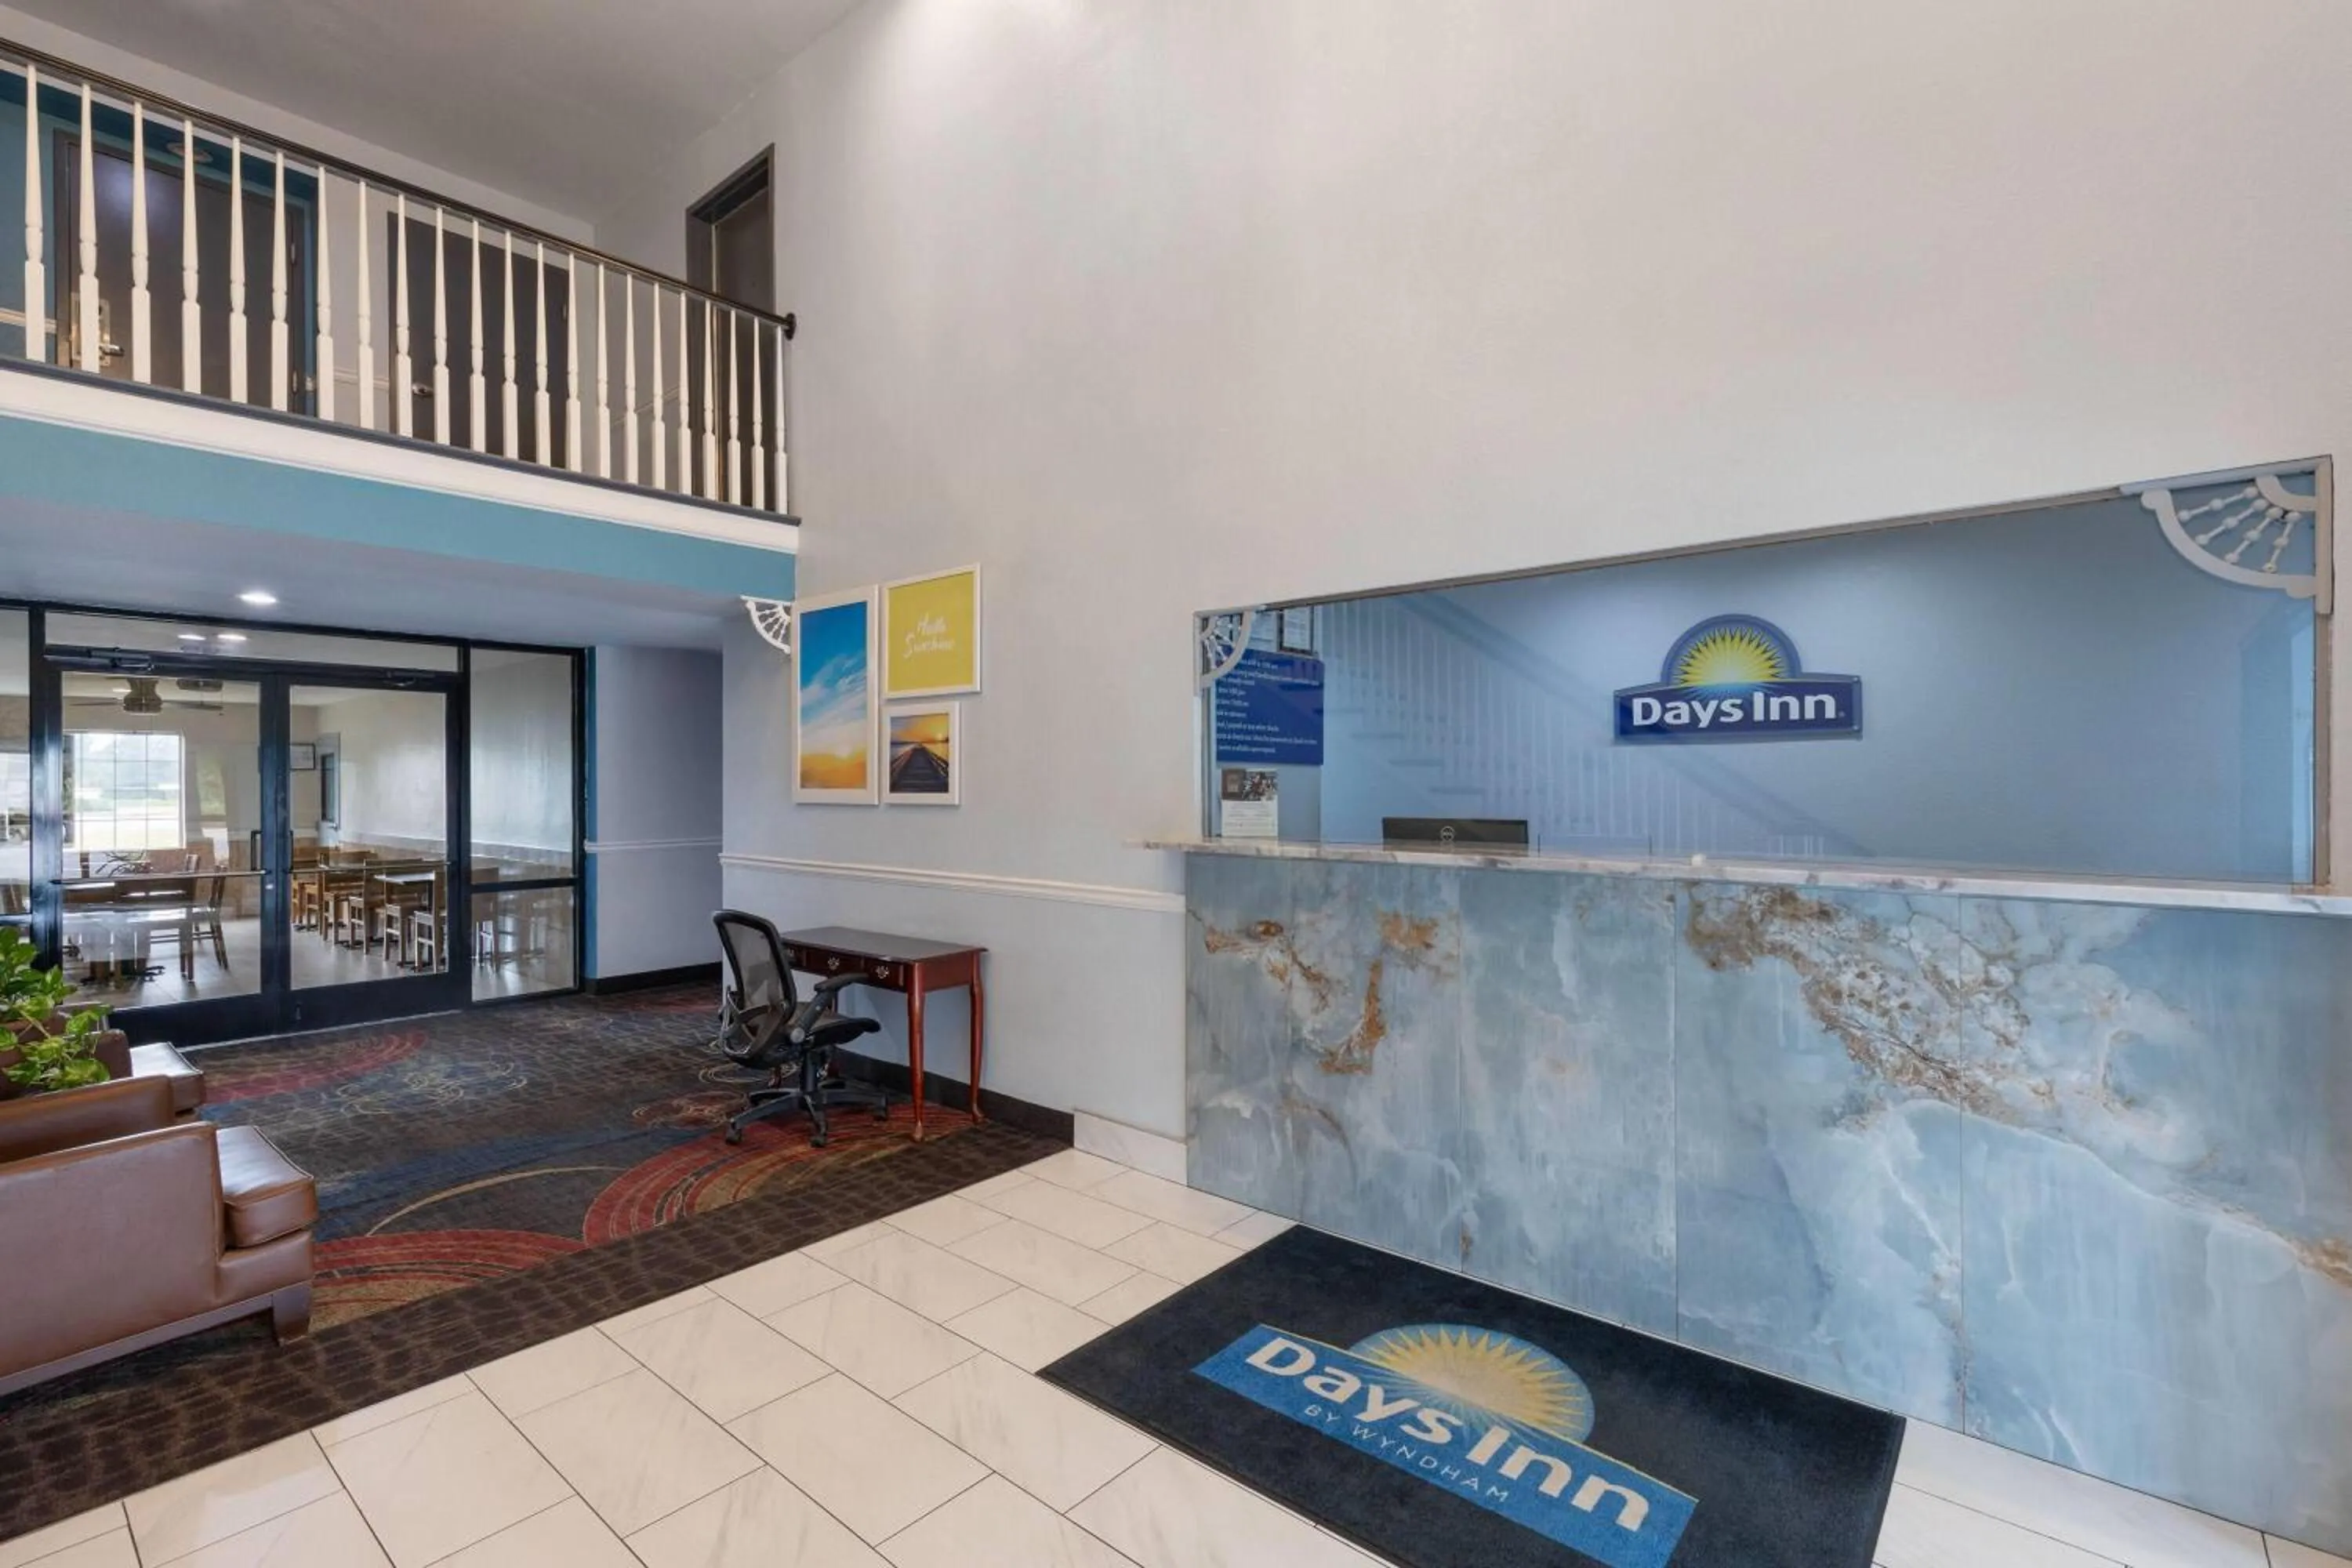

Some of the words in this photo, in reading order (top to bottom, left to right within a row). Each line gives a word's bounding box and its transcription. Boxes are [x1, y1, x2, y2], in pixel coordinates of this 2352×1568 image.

[1632, 697, 1744, 728] Days
[1752, 691, 1837, 721] Inn
[1245, 1336, 1463, 1444] Days
[1465, 1425, 1650, 1533] Inn
[1305, 1403, 1341, 1424] BY
[1352, 1424, 1510, 1503] WYNDHAM
